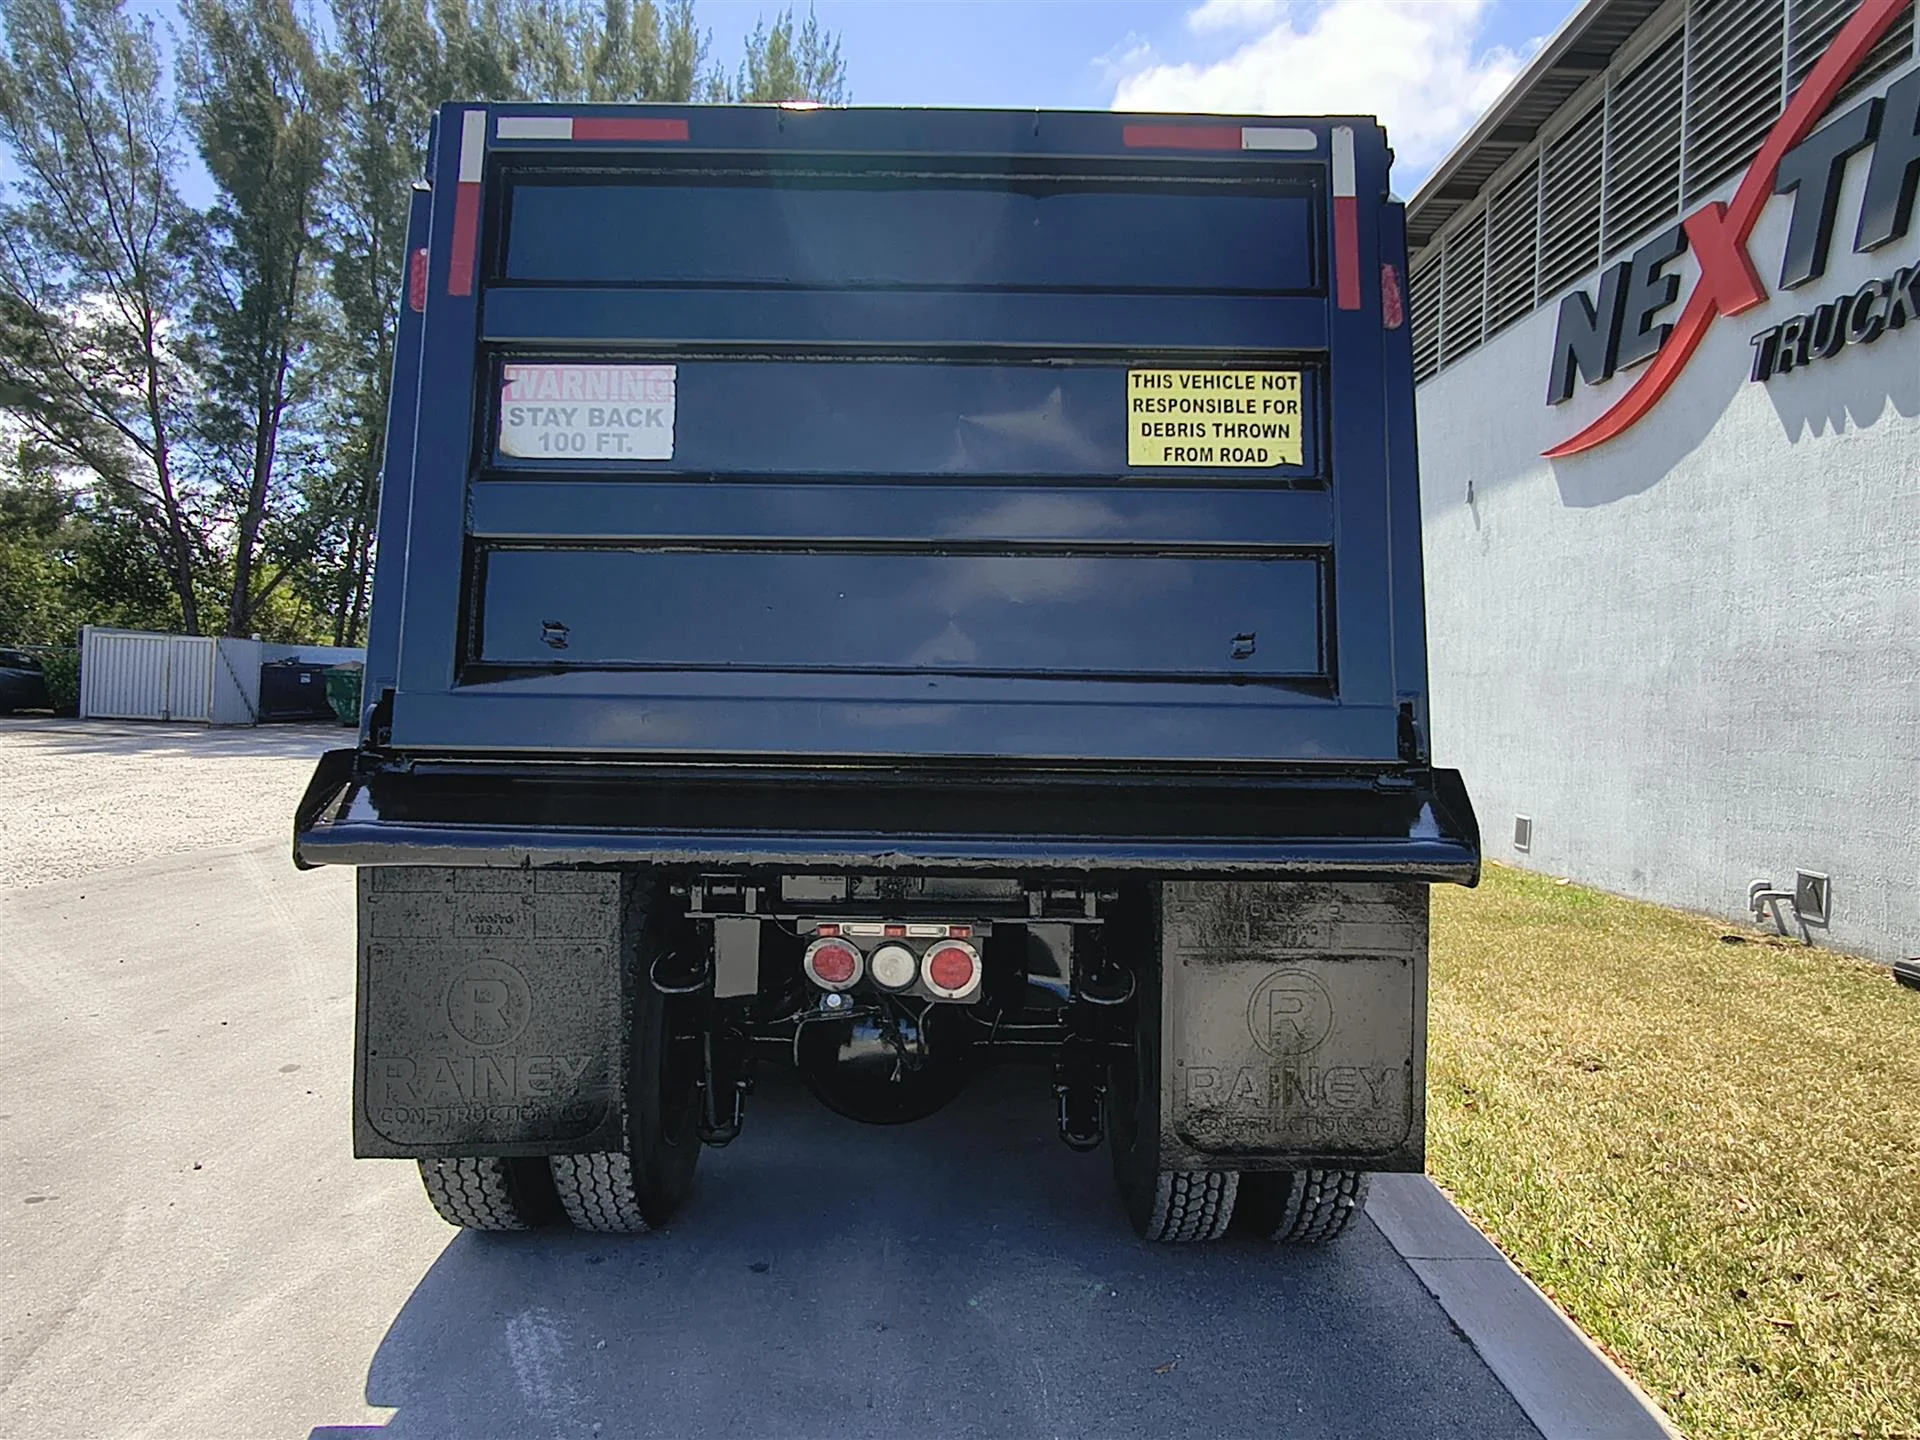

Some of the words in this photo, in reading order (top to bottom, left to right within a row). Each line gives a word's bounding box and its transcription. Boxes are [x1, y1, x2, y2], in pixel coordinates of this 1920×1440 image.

[508, 369, 672, 401] WARNING
[1131, 374, 1173, 389] THIS
[1179, 375, 1255, 390] VEHICLE
[1262, 376, 1297, 391] NOT
[1133, 398, 1256, 414] RESPONSIBLE
[1263, 400, 1298, 415] FOR
[509, 407, 579, 427] STAY
[588, 407, 665, 428] BACK
[1141, 422, 1206, 438] DEBRIS
[1212, 423, 1290, 439] THROWN
[538, 432, 586, 452] 100
[596, 433, 633, 453] FT.
[1163, 447, 1214, 462] FROM
[1220, 448, 1269, 463] ROAD
[464, 979, 512, 1030] R
[1268, 989, 1311, 1045] R
[376, 1055, 593, 1100] RAINEY
[1186, 1066, 1399, 1110] RAINEY
